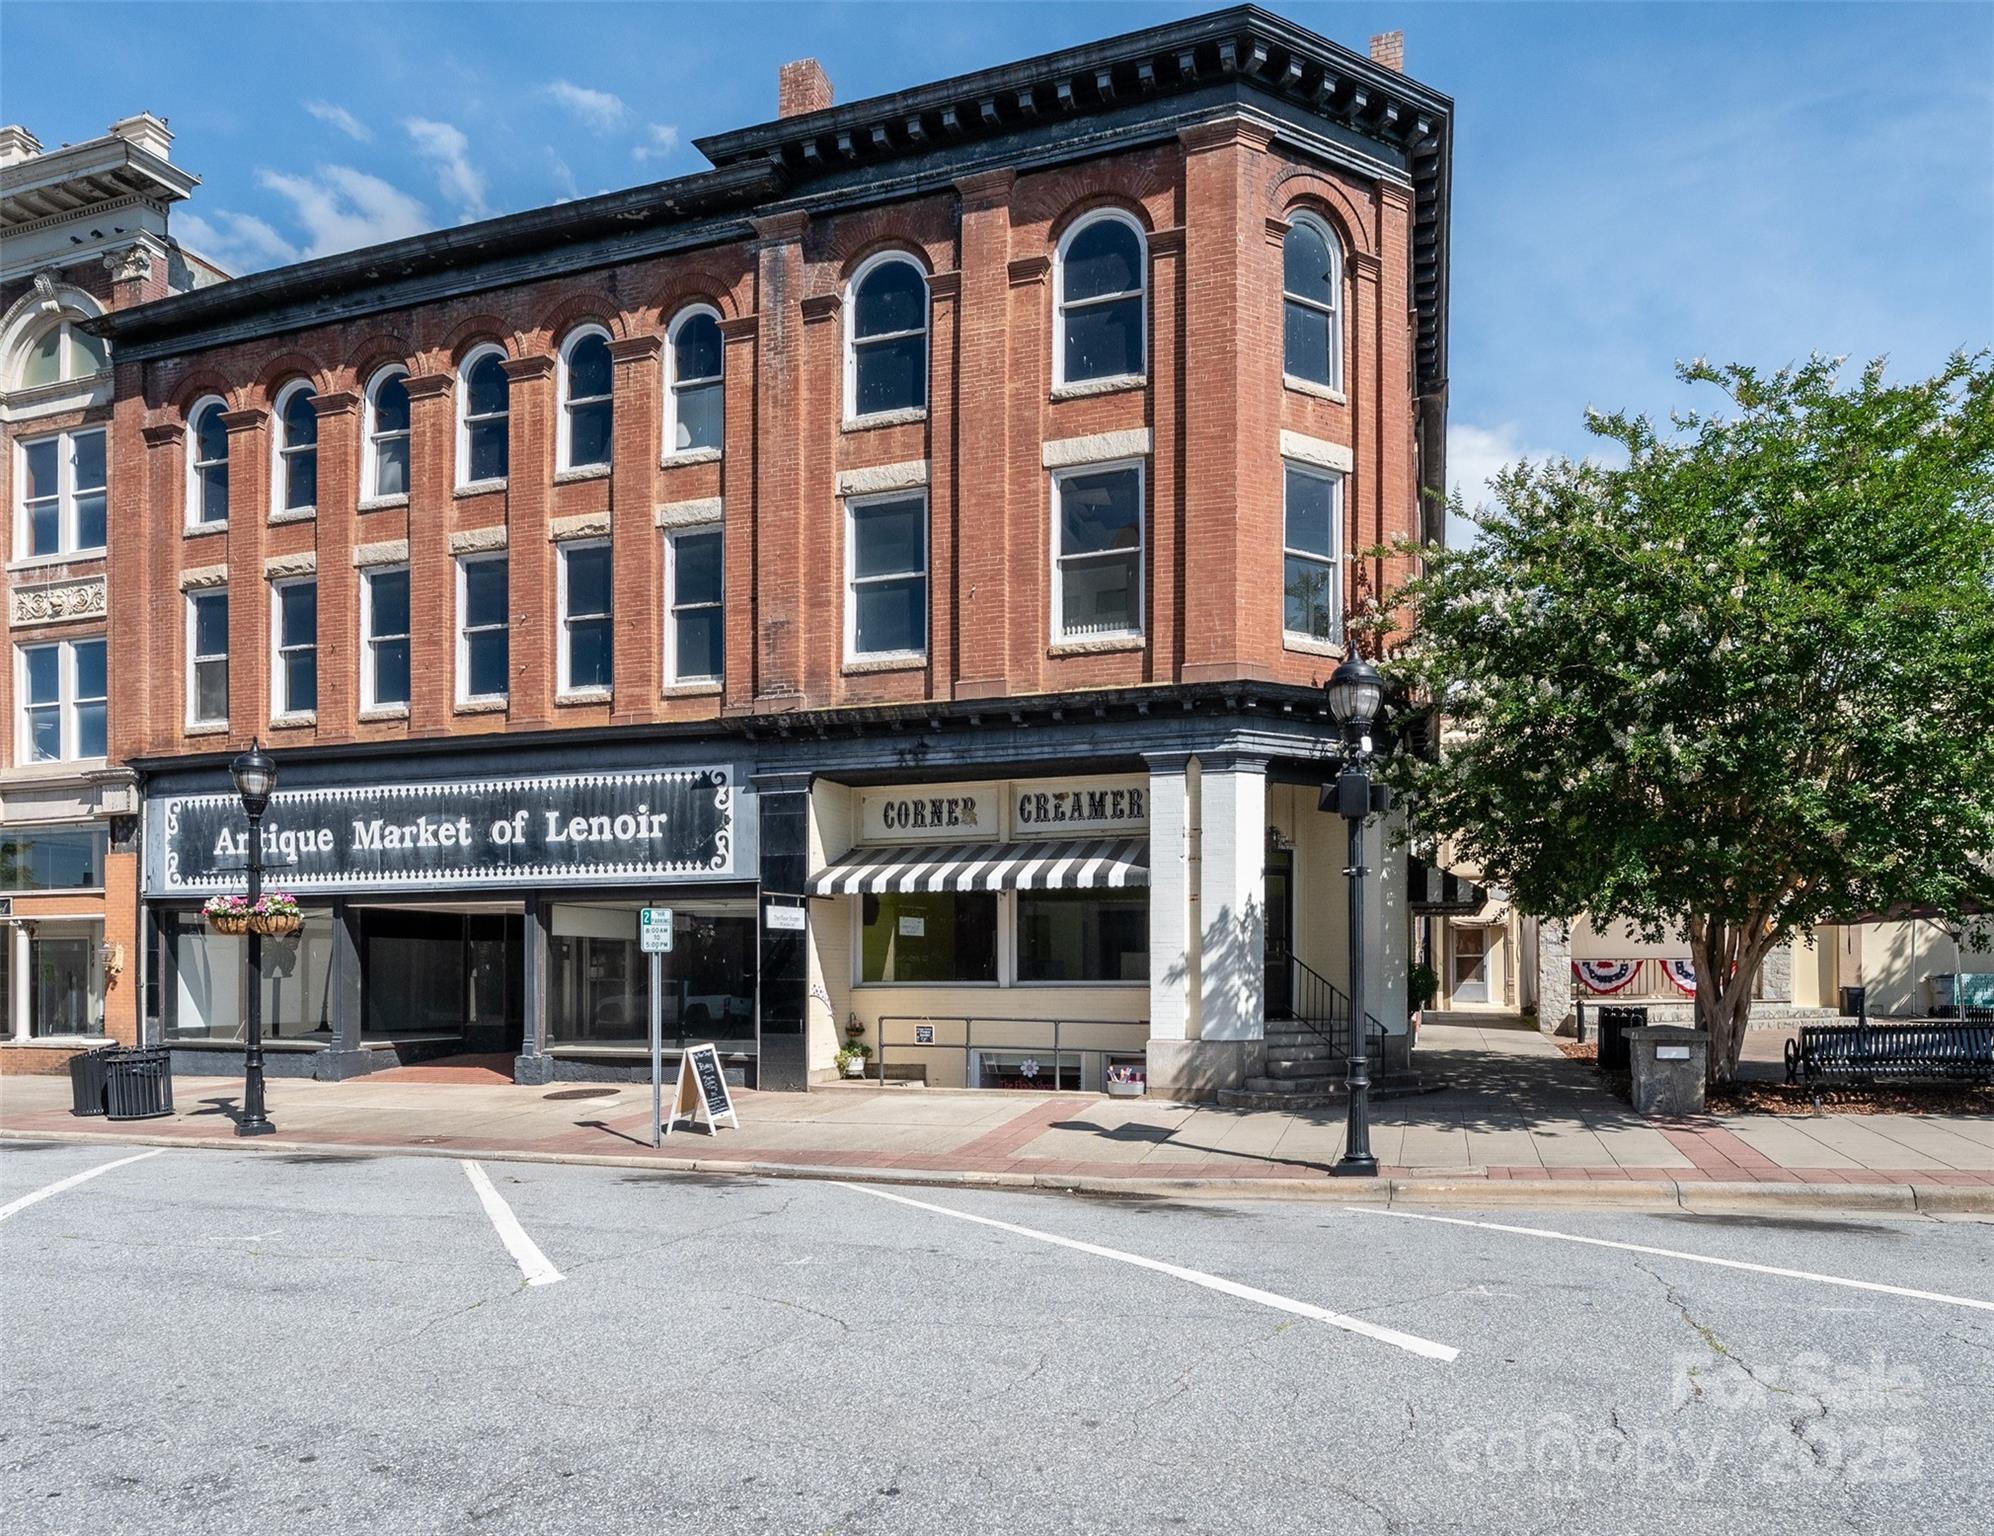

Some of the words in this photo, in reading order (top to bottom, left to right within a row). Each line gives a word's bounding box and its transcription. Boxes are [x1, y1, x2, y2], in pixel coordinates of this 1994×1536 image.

[1019, 788, 1150, 823] CREAMER
[352, 815, 472, 850] Market
[491, 810, 529, 845] of
[545, 804, 668, 842] Lenoir
[643, 911, 650, 923] 2
